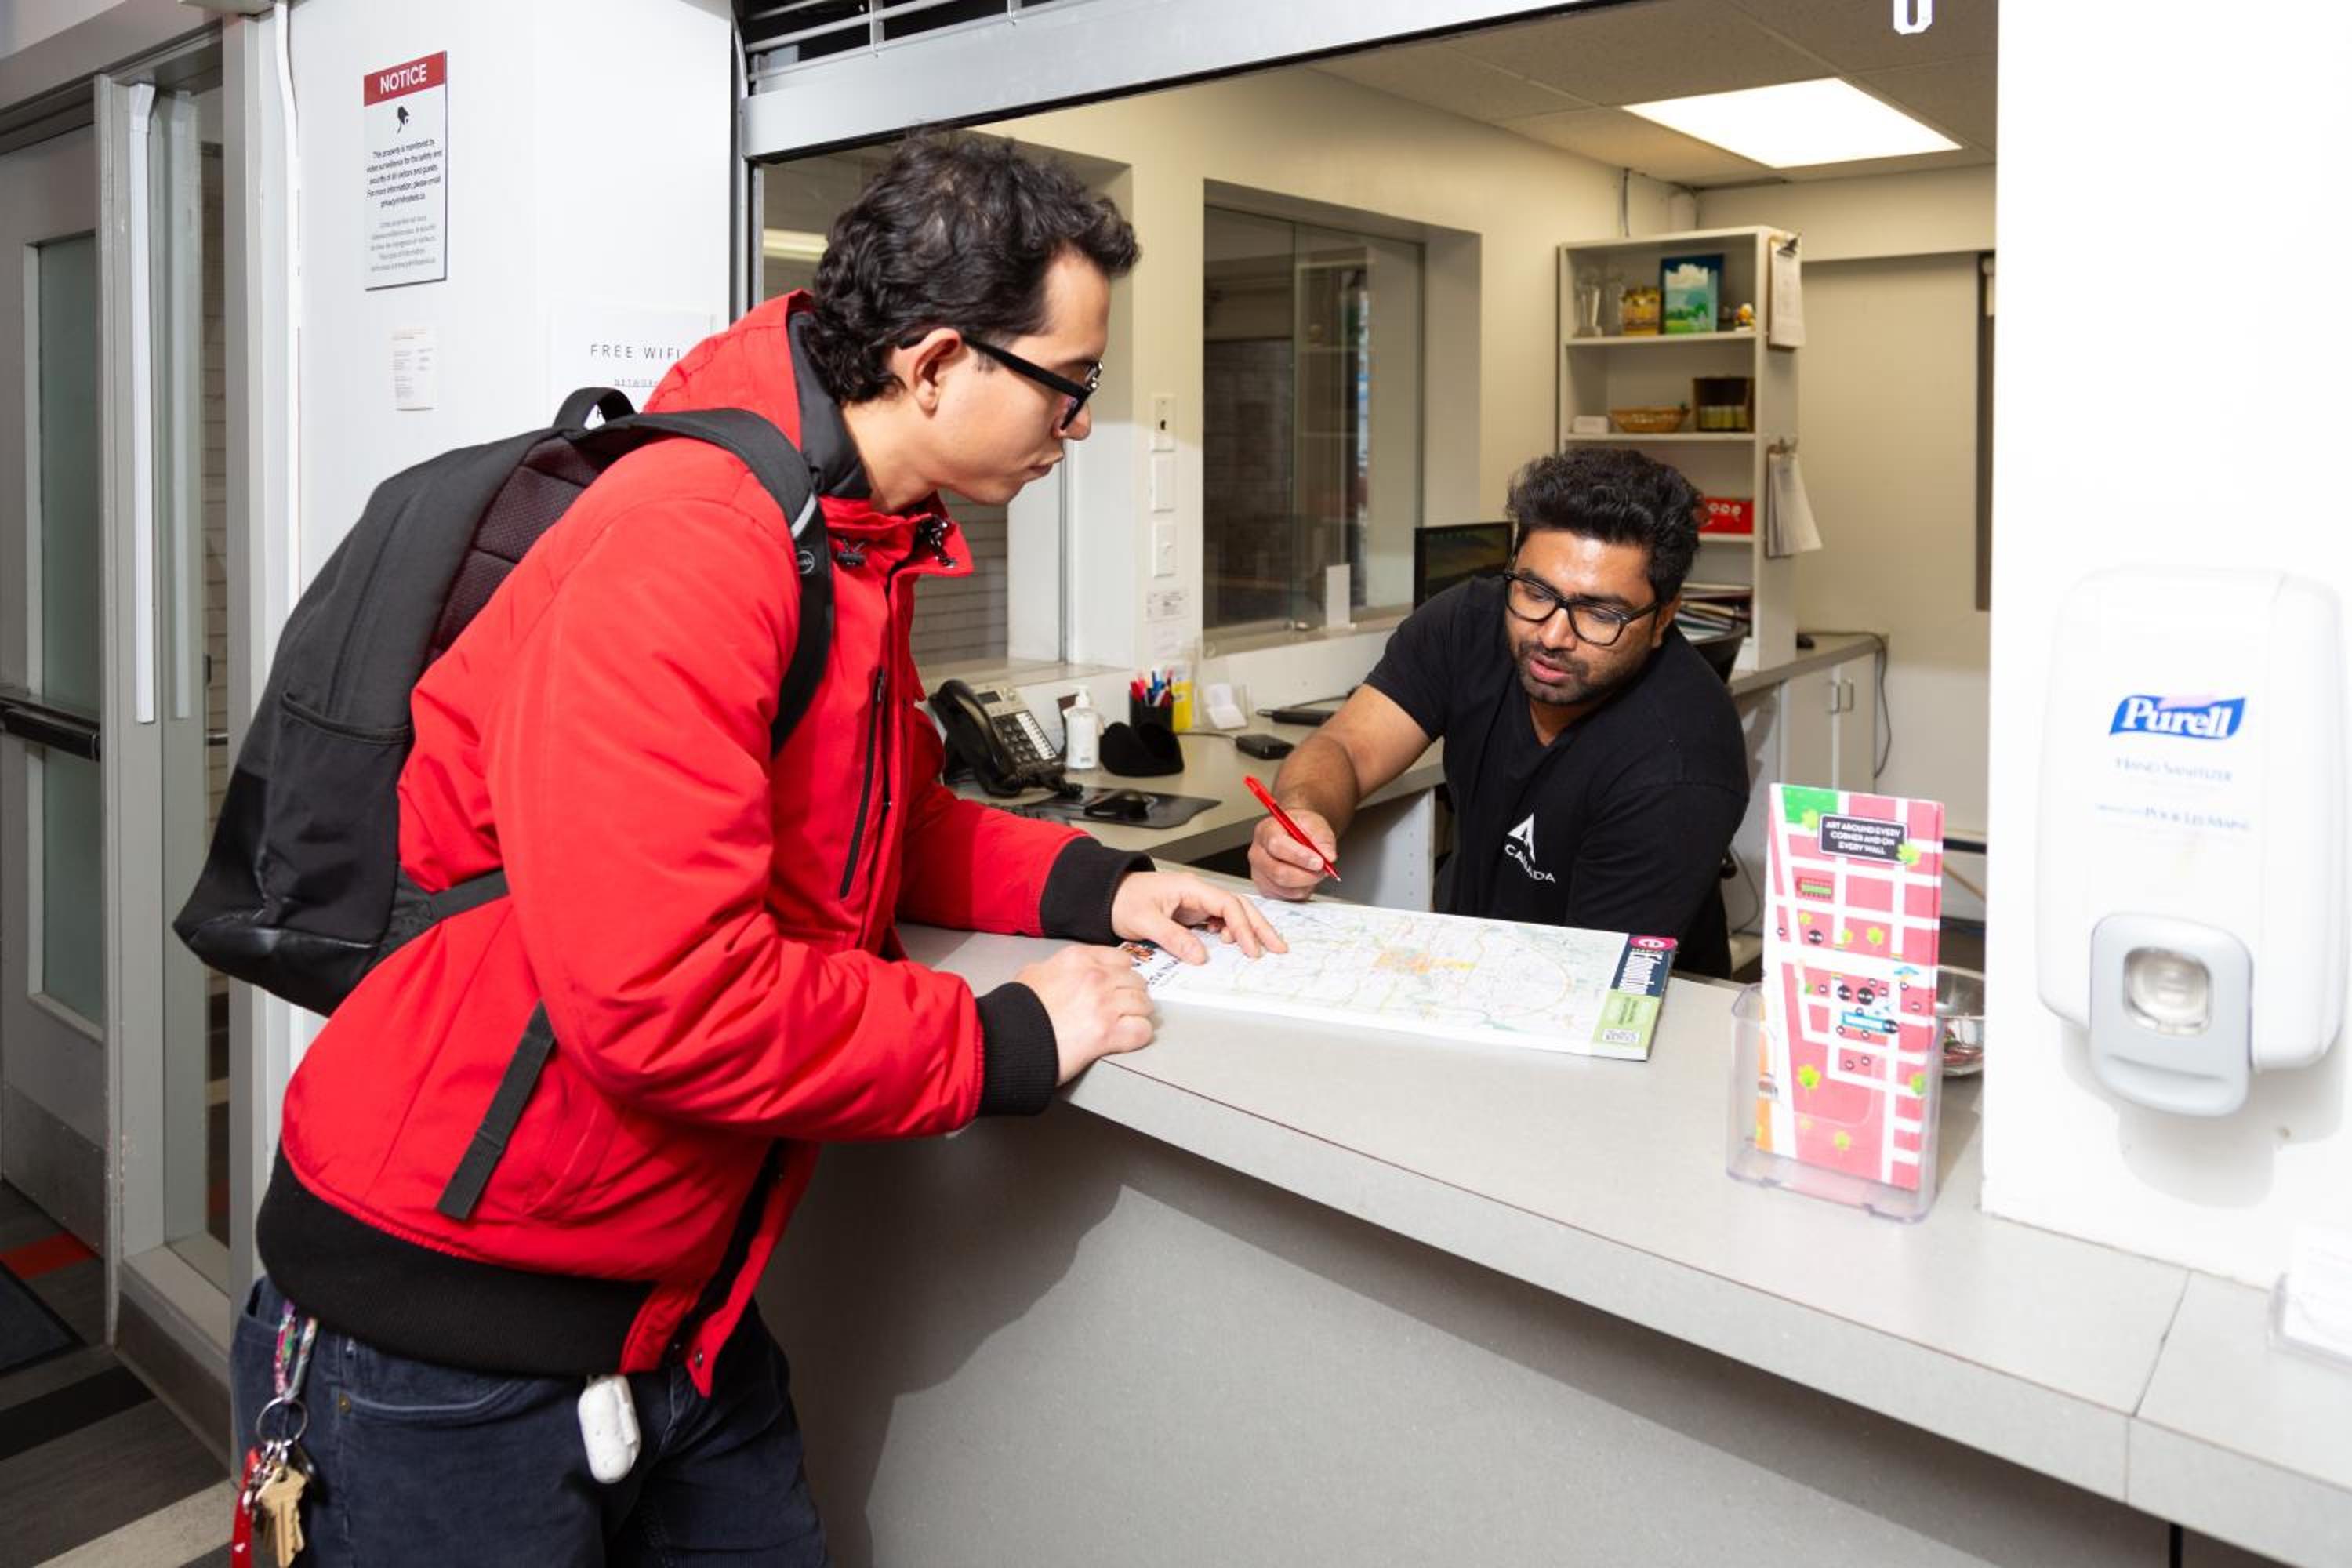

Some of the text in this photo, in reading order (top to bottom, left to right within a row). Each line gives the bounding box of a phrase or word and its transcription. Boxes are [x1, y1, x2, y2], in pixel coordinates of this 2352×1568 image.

[380, 63, 427, 95] NOTICE
[590, 343, 681, 360] FREE WIFI
[2121, 697, 2233, 739] Purell
[1825, 821, 1840, 829] ART
[1841, 822, 1875, 834] AROUND
[1830, 830, 1864, 842] CORNER
[1838, 840, 1886, 855] EVERY WALL
